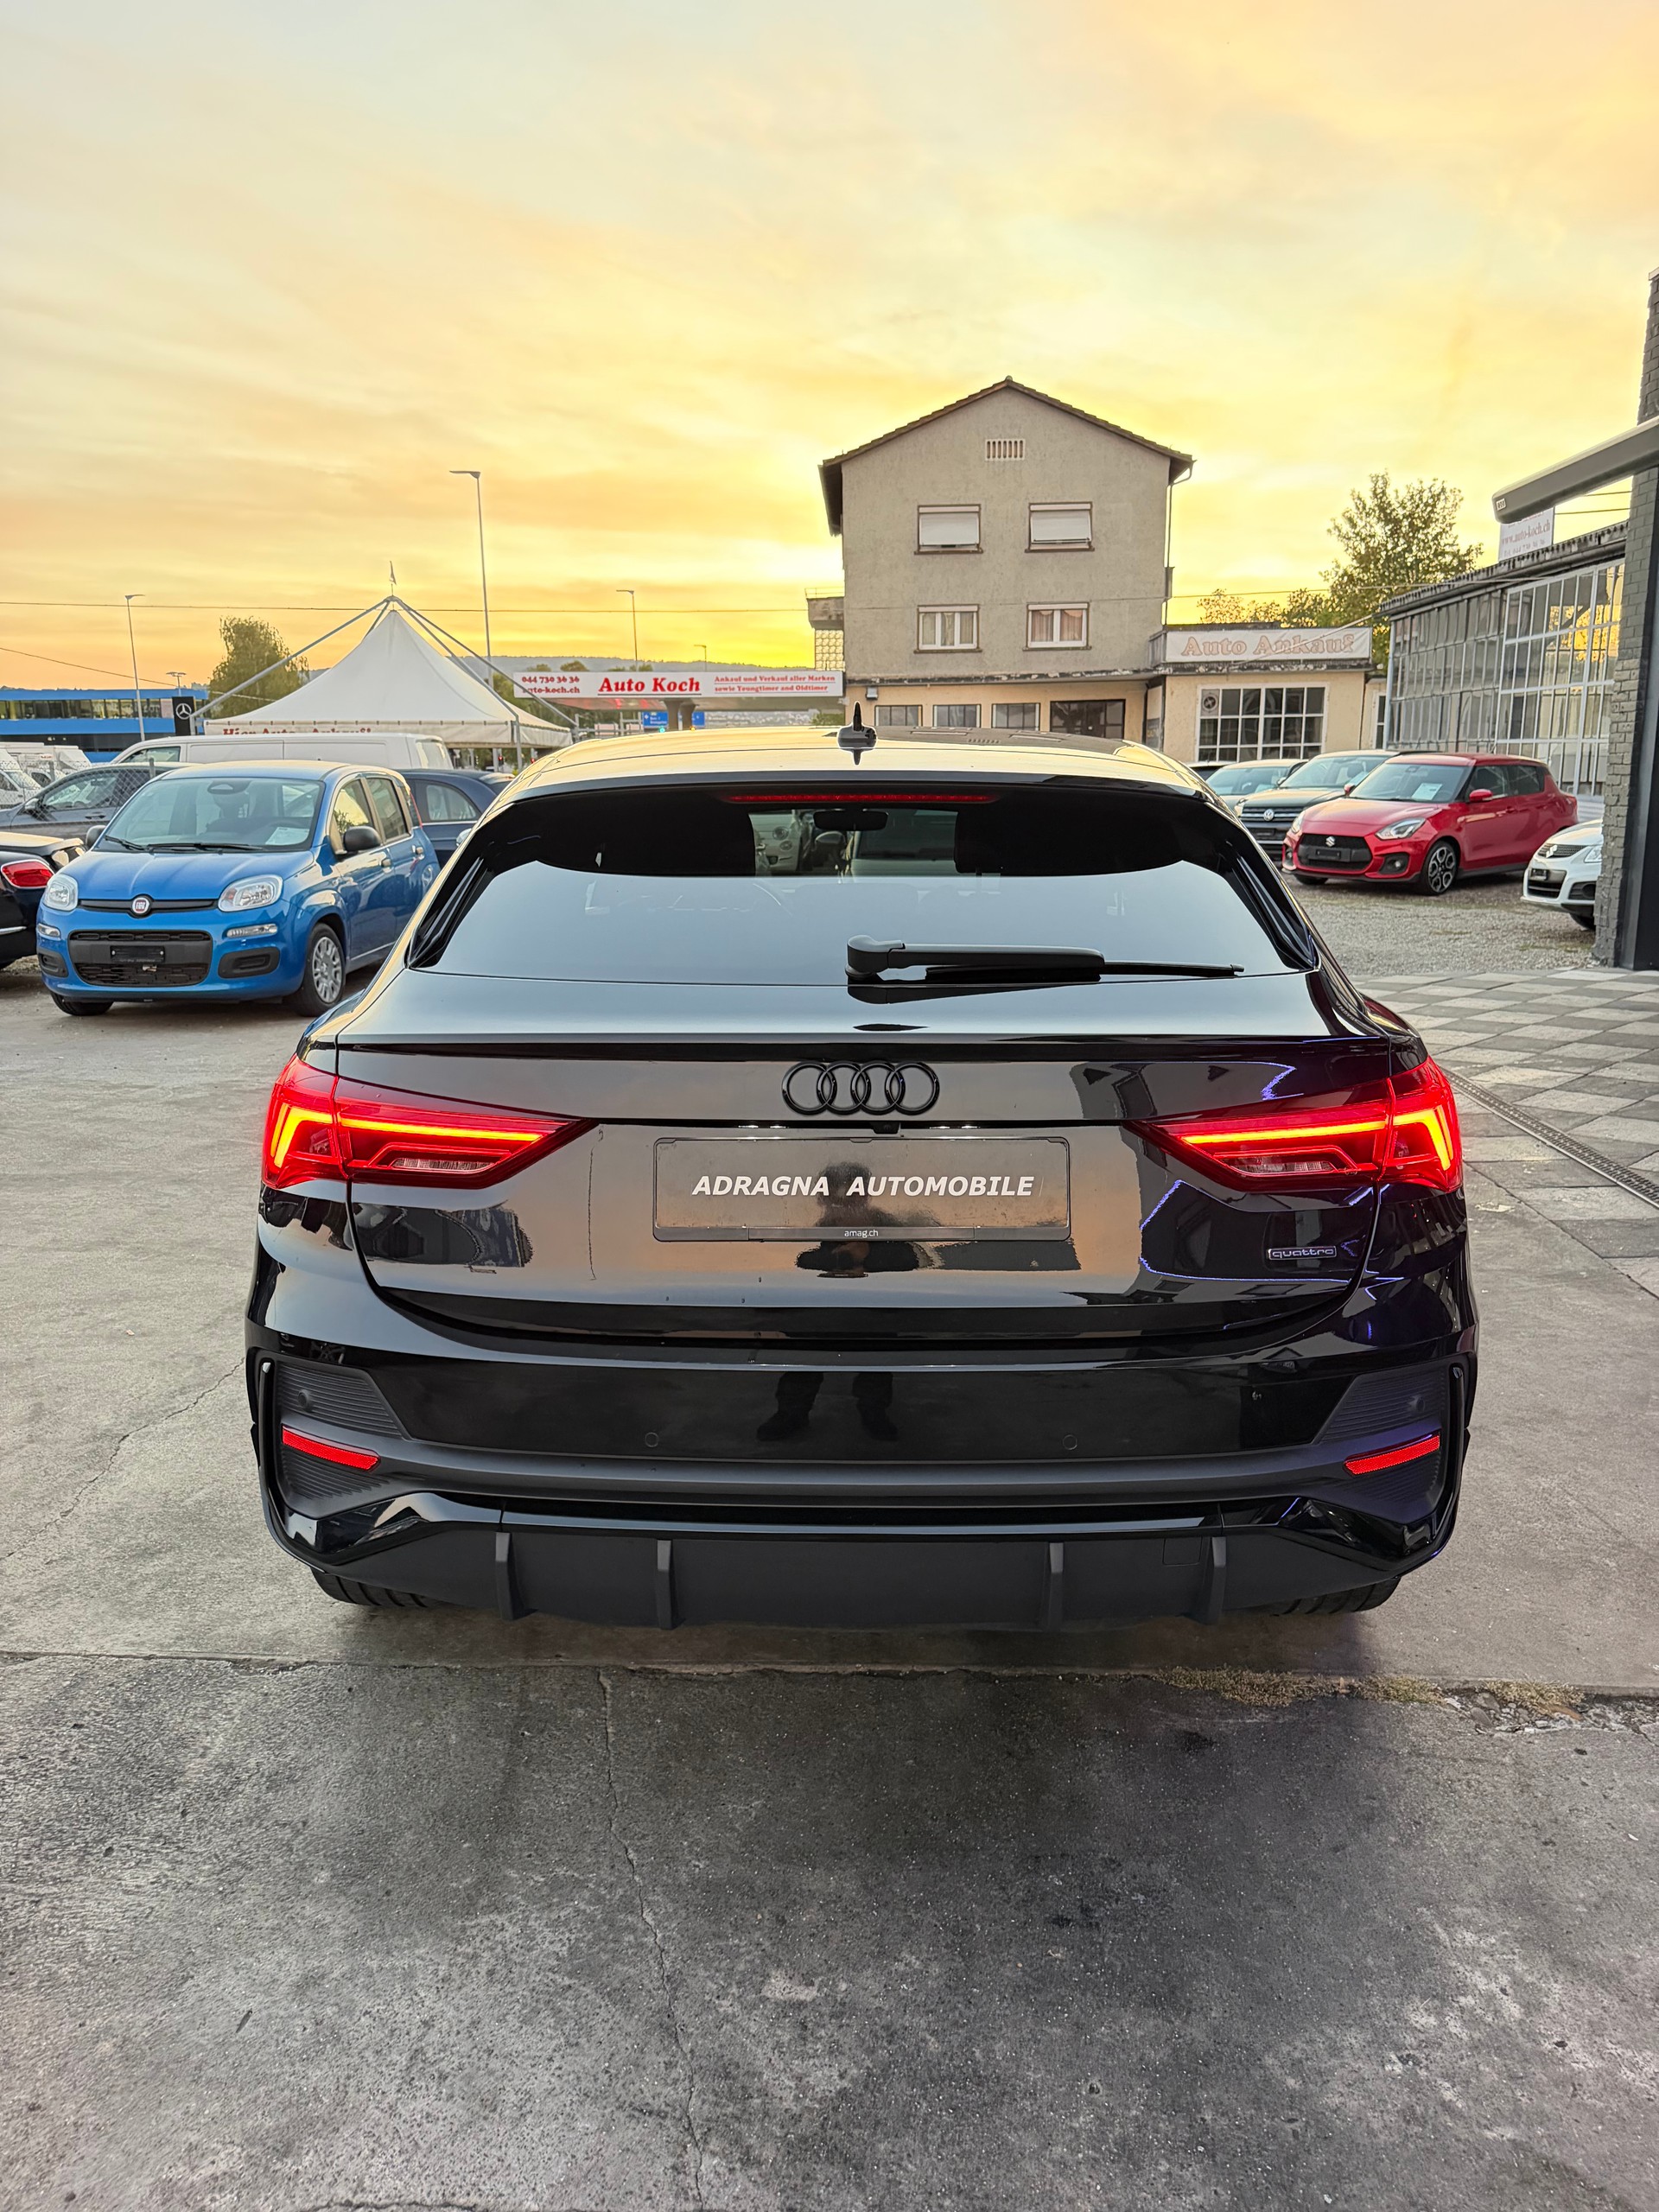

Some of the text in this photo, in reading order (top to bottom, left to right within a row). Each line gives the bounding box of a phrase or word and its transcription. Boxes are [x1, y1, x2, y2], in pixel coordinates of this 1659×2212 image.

[1180, 633, 1355, 656] Auto Ankauf
[598, 677, 701, 692] Auto Koch
[691, 1175, 1035, 1197] ADRAGNA AUTOMOBILE
[843, 1228, 880, 1239] amag.ch
[1271, 1249, 1335, 1259] quattro
